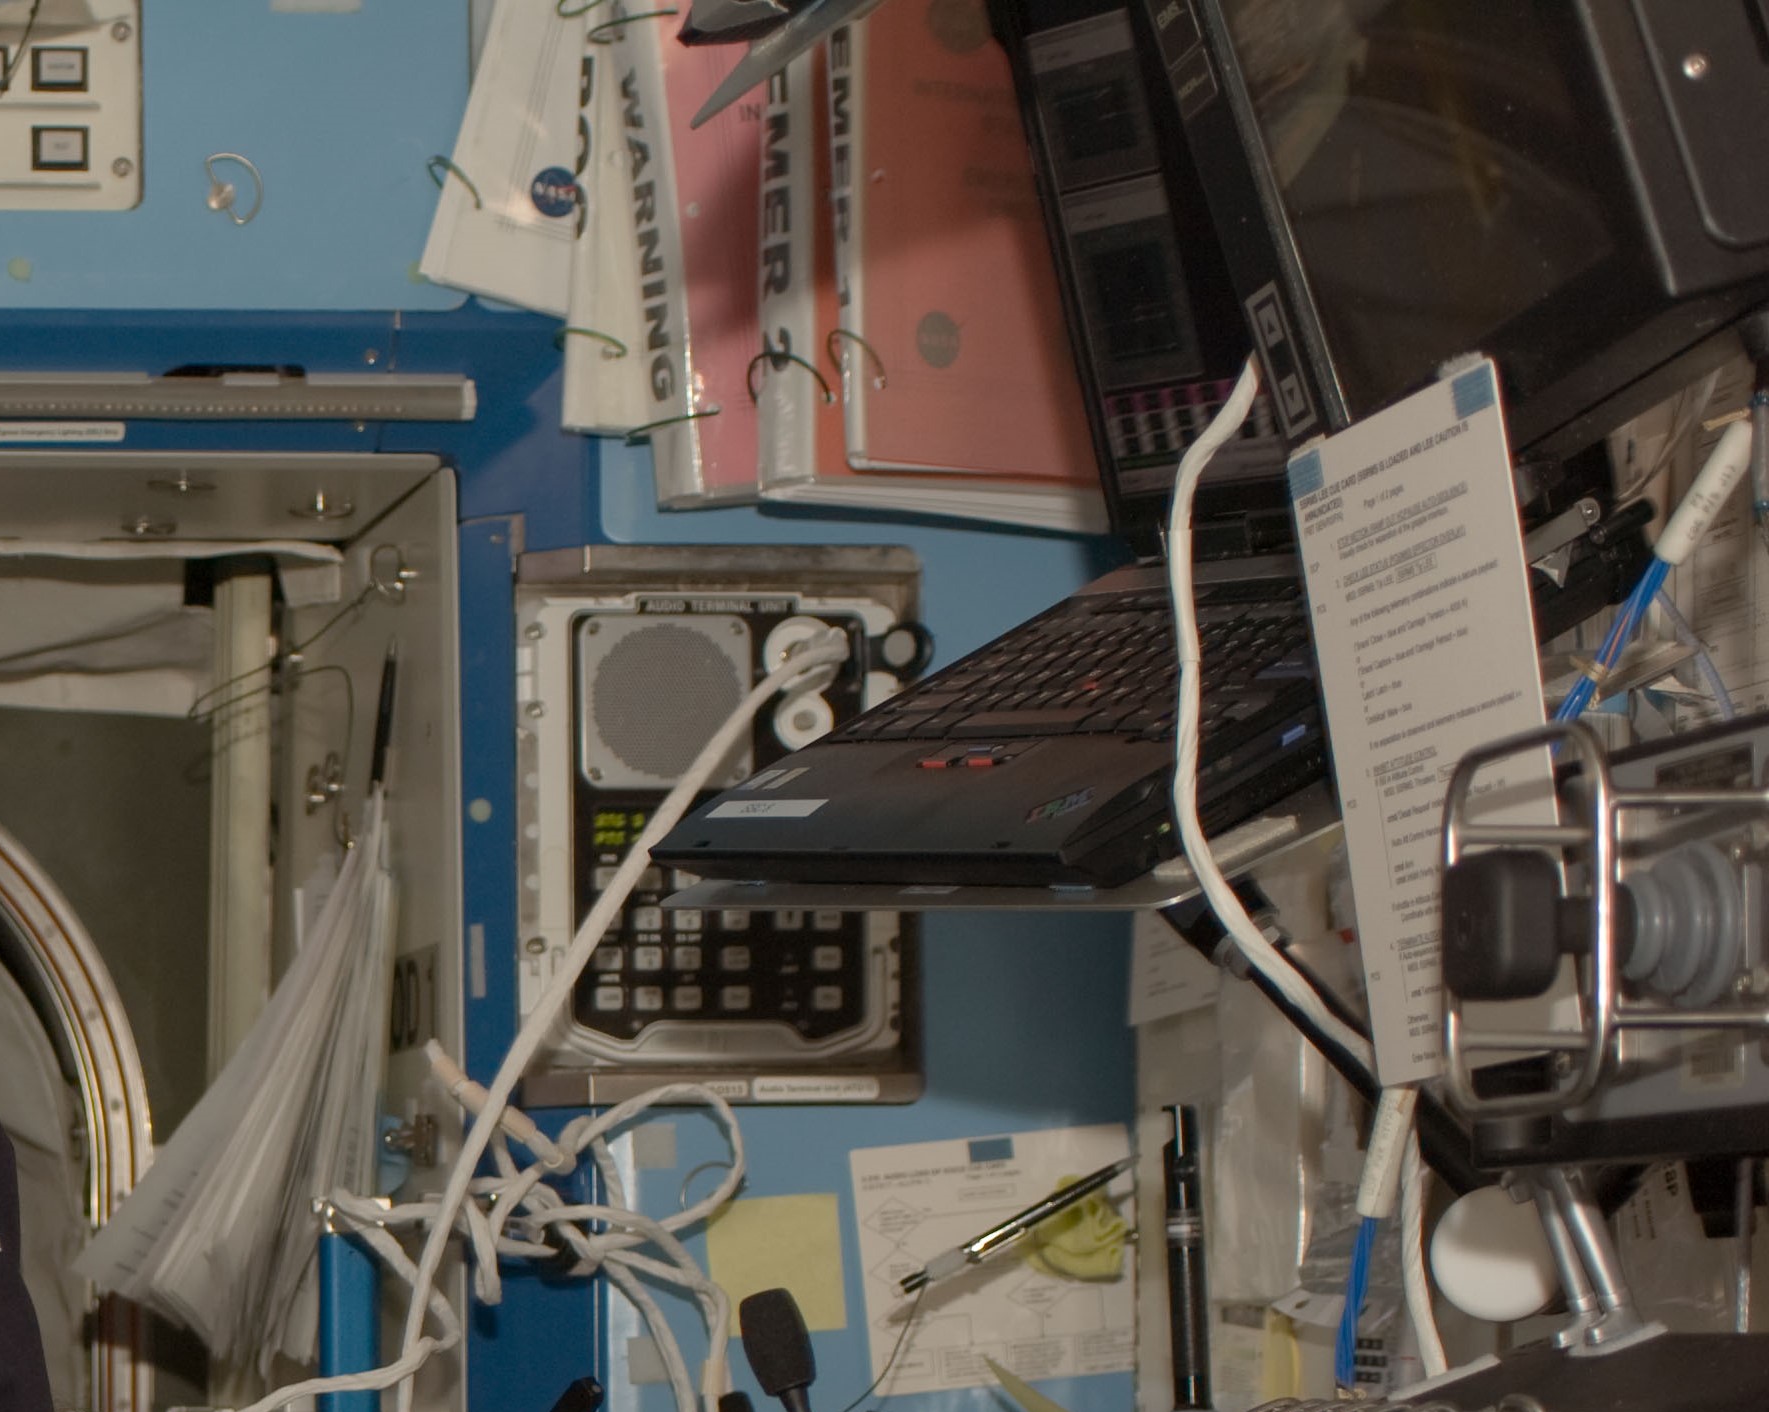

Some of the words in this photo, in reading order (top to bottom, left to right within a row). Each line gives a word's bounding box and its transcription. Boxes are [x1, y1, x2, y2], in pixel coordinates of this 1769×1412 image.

[618, 65, 677, 404] WARNING
[645, 600, 685, 613] AUDIO
[690, 600, 753, 613] TERMINAL
[757, 600, 791, 613] UNIT
